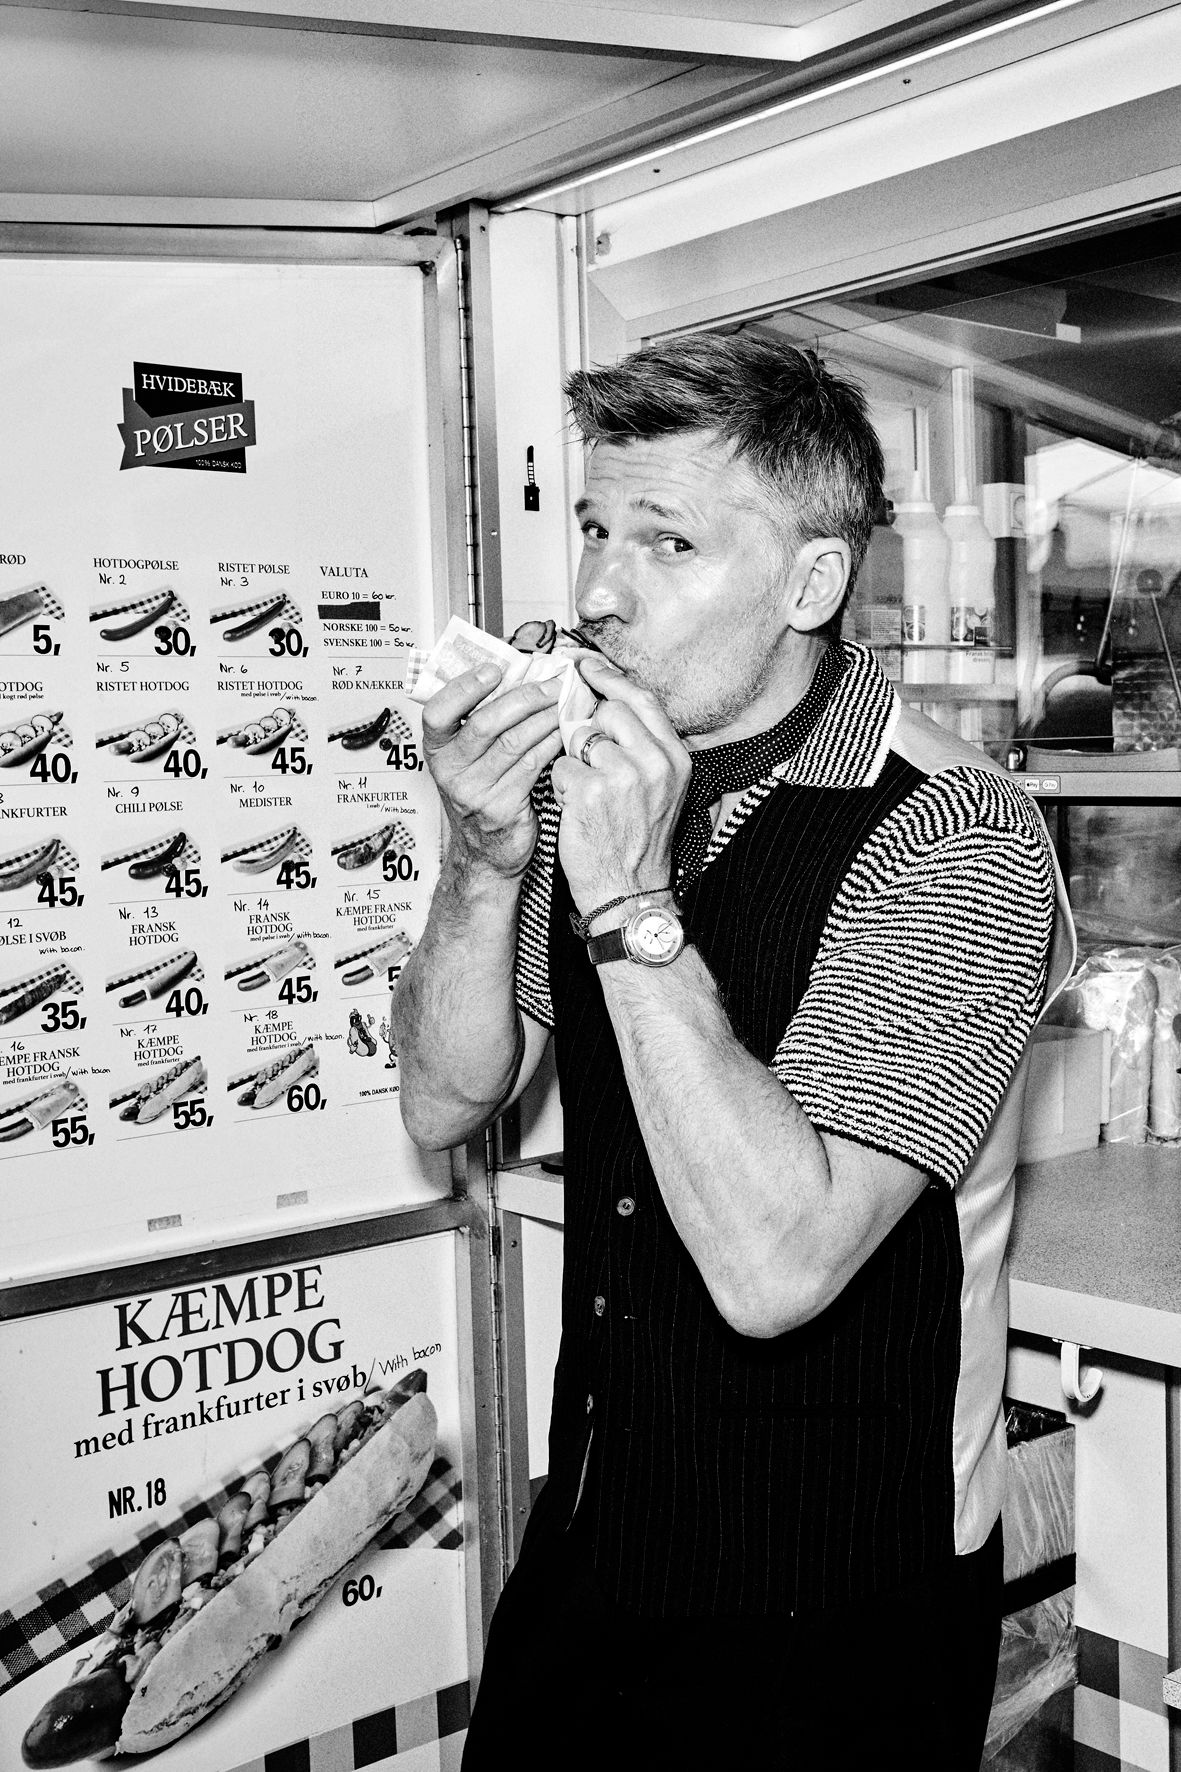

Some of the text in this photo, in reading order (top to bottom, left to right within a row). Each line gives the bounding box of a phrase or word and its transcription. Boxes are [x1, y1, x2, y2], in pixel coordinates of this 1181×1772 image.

[142, 374, 235, 397] HVIDEBÆK
[134, 413, 248, 456] PØLSER
[93, 558, 180, 570] HOTDOGPØLSE
[218, 562, 290, 574] RISTET PØLSE
[99, 573, 126, 585] Nr. 2
[320, 567, 368, 578] VALUTA
[221, 577, 249, 586] Nr. 3
[321, 591, 349, 600] EURO
[352, 592, 360, 600] 10
[372, 592, 383, 600] 60
[323, 623, 363, 632] NORSKE
[366, 624, 378, 632] 100
[389, 624, 399, 632] 50
[154, 626, 196, 656] 30,
[268, 627, 309, 657] 30,
[324, 638, 367, 647] SVENSKE
[370, 639, 382, 647] 100
[394, 638, 404, 647] 50
[97, 662, 129, 672] Nr. 5
[220, 663, 248, 674] Nr. 6
[333, 666, 362, 676] Nr. 7
[96, 681, 190, 692] RISTET HOTDOG
[217, 681, 303, 691] RISTET HOTDOG
[332, 681, 404, 690] RØD KNÆKKER
[164, 749, 208, 779] 40,
[272, 747, 313, 774] 45,
[387, 744, 424, 771] 45,
[30, 753, 78, 784] 40,
[230, 781, 264, 793] Nr. 10
[339, 777, 367, 789] Nr. 11
[107, 786, 139, 798] Nr. 9
[337, 792, 408, 803] FRANKFURTER
[116, 801, 183, 814] CHILI PØLSE
[239, 797, 292, 808] MEDISTER
[0, 806, 68, 819] NKFURTER
[383, 855, 419, 882] 50,
[276, 862, 317, 889] 45,
[165, 869, 208, 897] 45,
[37, 876, 84, 907] 45,
[344, 889, 380, 903] Nr. 15
[234, 898, 270, 912] Nr. 14
[336, 902, 412, 917] KÆMPE FRANSK
[119, 906, 158, 919] Nr. 13
[249, 912, 290, 924] FRANSK
[7, 918, 23, 928] 12
[353, 914, 396, 926] HOTDOG
[131, 922, 176, 934] FRANSK
[247, 923, 293, 935] HOTDOG
[29, 934, 33, 943] I
[36, 931, 66, 942] SVØB
[129, 933, 179, 946] HOTDOG
[278, 976, 318, 1004] 45,
[166, 988, 209, 1018] 40,
[41, 1000, 87, 1032] 35,
[266, 1010, 278, 1019] 18
[120, 1024, 157, 1038] Nr. 17
[254, 1021, 293, 1034] KÆMPE
[137, 1035, 179, 1048] KÆMPE
[251, 1032, 297, 1046] HOTDOG
[10, 1041, 25, 1051] 16
[33, 1047, 80, 1062] FRANSK
[134, 1046, 183, 1060] HOTDOG
[7, 1061, 60, 1077] HOTDOG
[287, 1083, 327, 1112] 60,
[173, 1098, 214, 1130] 55,
[52, 1115, 95, 1148] 55,
[114, 1265, 325, 1351] KÆMPE
[414, 1342, 442, 1360] bacon
[96, 1318, 345, 1417] HOTDOG
[74, 1419, 133, 1459] med
[142, 1385, 290, 1441] frankfurter
[298, 1378, 306, 1401] i
[342, 1574, 383, 1607] 60,
